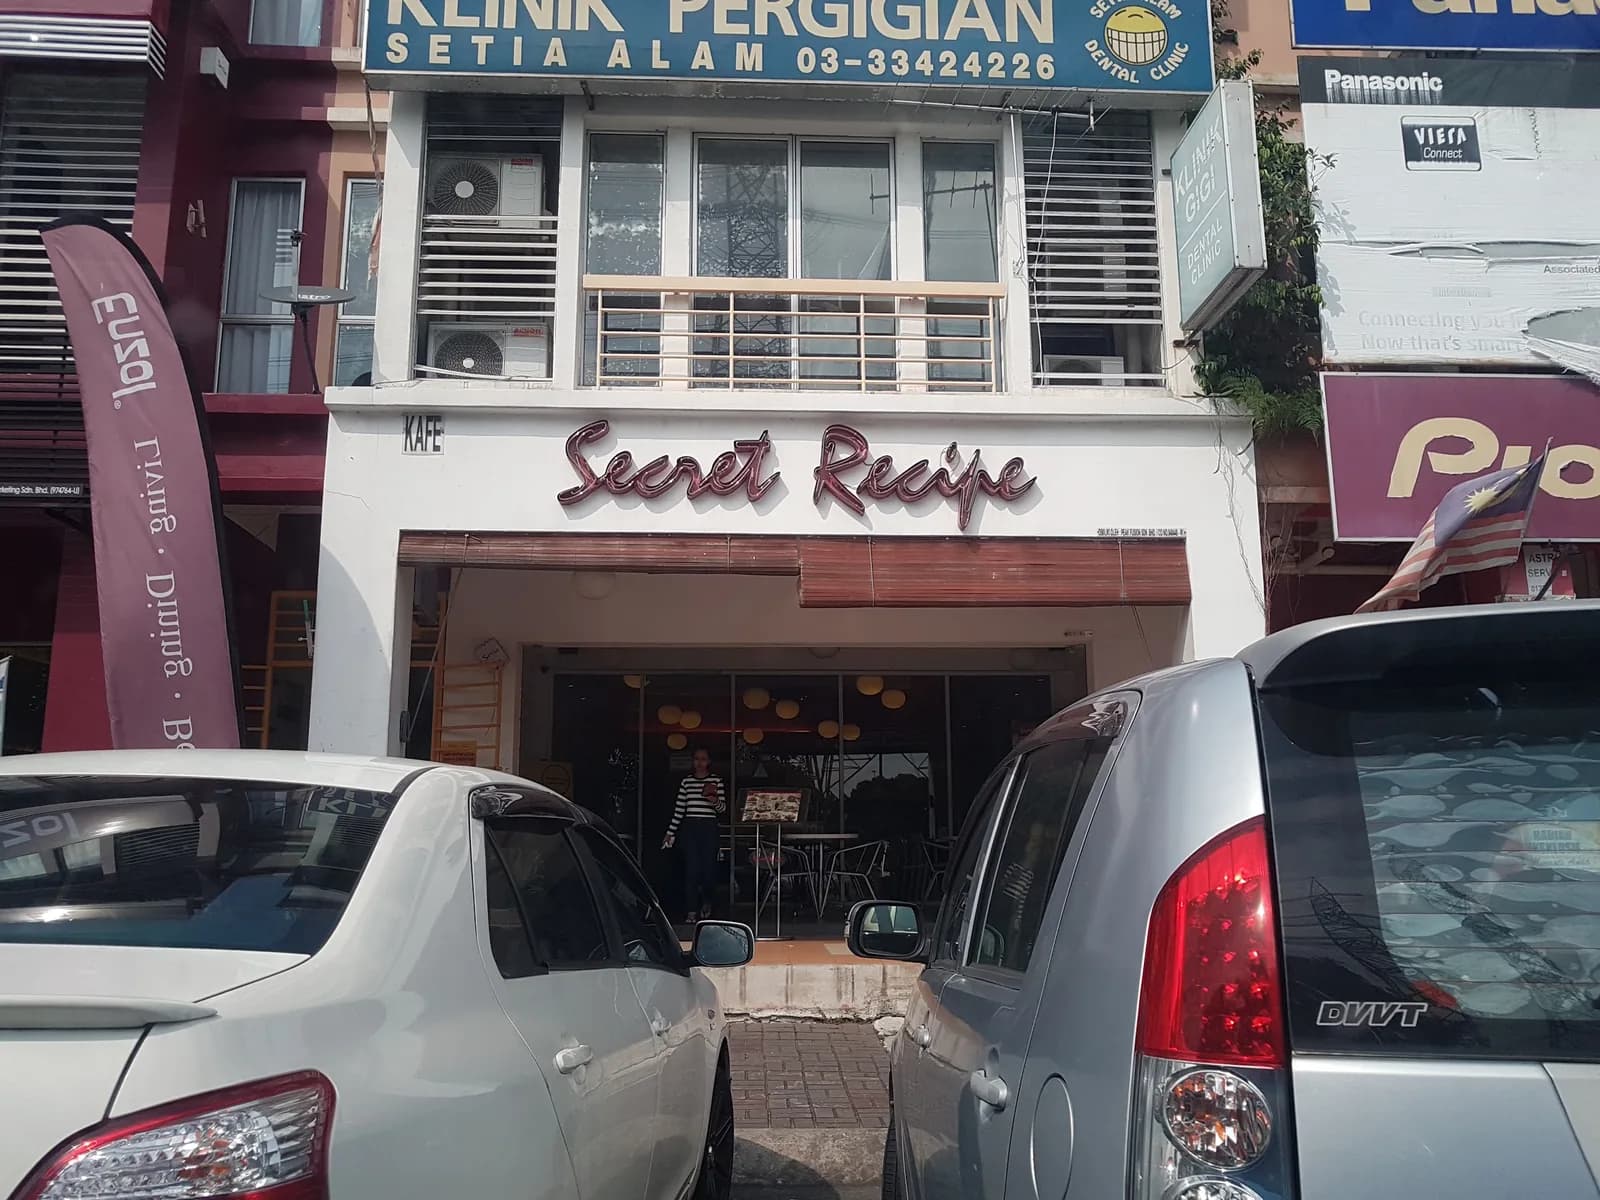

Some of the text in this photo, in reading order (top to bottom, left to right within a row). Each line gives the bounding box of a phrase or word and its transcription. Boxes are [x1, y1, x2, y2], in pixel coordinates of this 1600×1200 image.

[386, 33, 1056, 80] SETIA ALAM 03-33424226
[1084, 39, 1189, 84] DENTAL CLINIC
[1324, 69, 1443, 92] Panasonic
[1174, 115, 1223, 203] KLINIK
[1423, 147, 1463, 159] Connect
[1185, 164, 1216, 223] GIGI
[1187, 218, 1223, 270] DENTAL
[1190, 239, 1222, 286] CLINIC
[403, 415, 442, 452] KAFE
[557, 419, 1039, 532] Secret Recipe
[1317, 1001, 1428, 1027] DVVT
